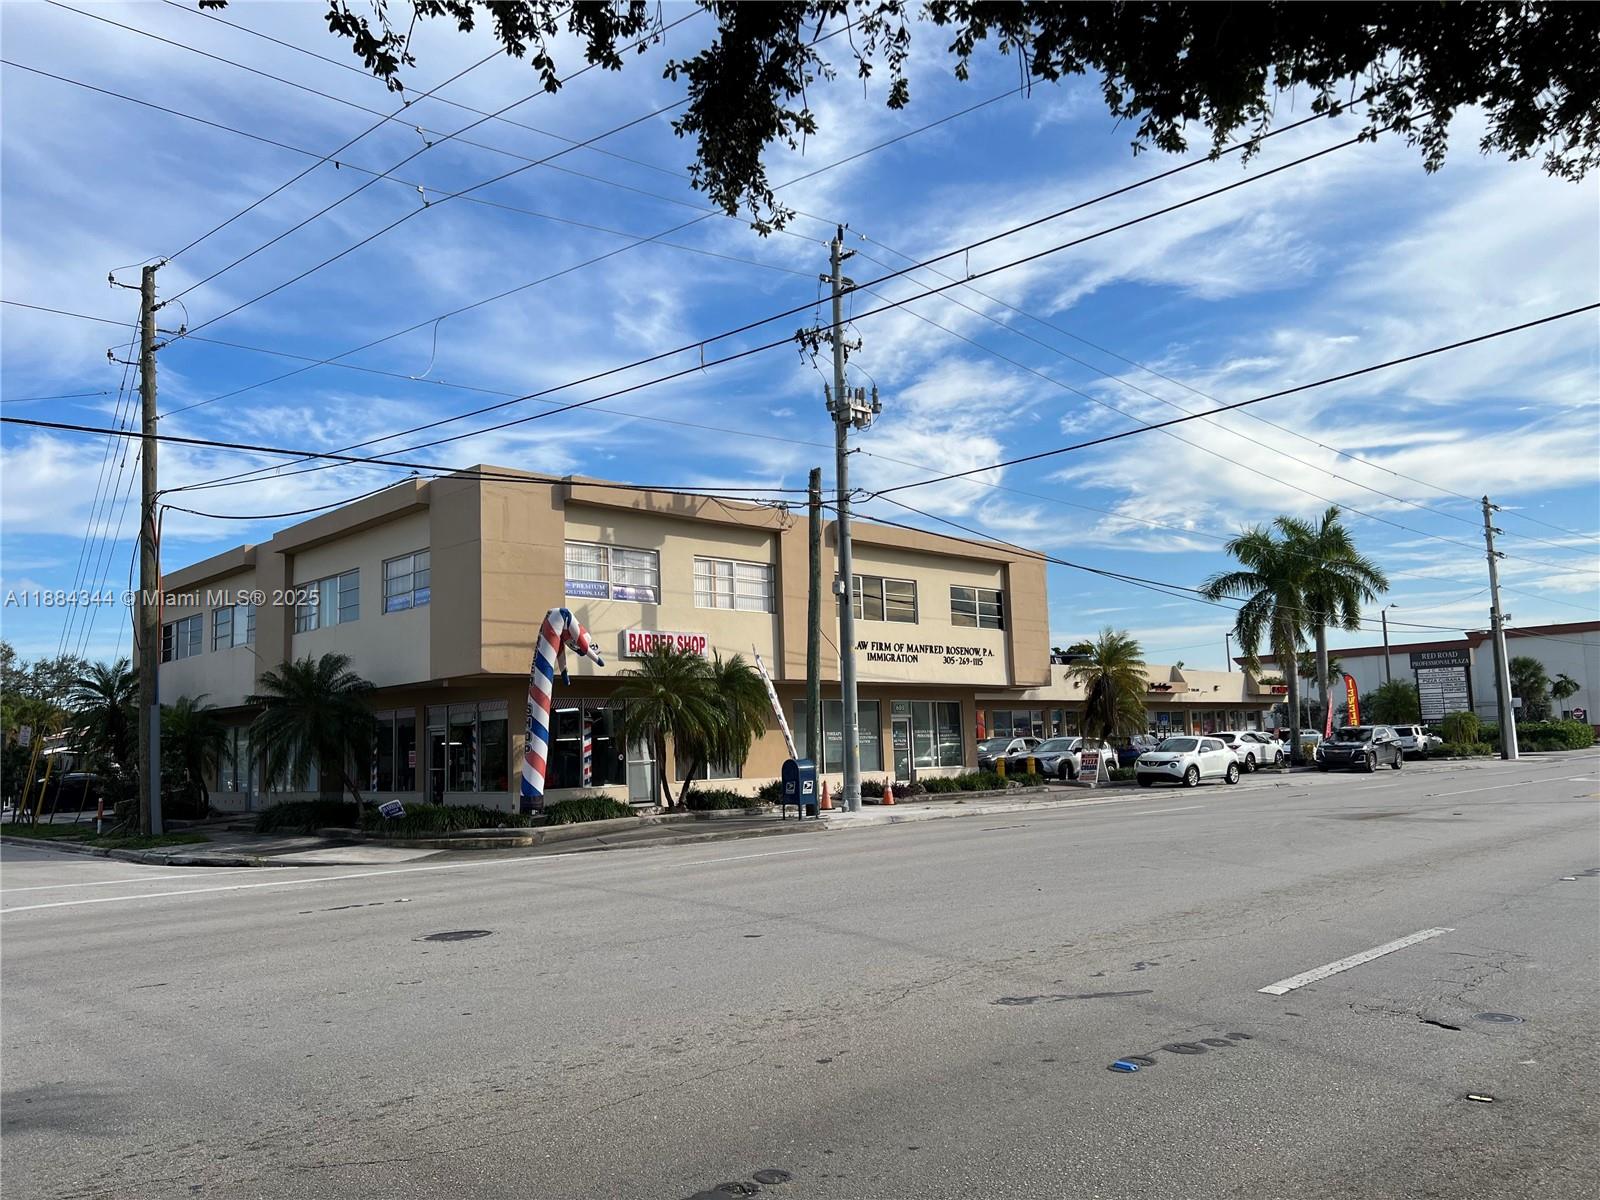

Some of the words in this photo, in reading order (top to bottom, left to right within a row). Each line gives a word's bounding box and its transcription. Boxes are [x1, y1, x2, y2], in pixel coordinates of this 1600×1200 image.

[677, 635, 706, 656] SHOP
[854, 641, 868, 650] AW
[871, 642, 891, 651] FIRM
[894, 643, 905, 652] OF
[907, 644, 944, 654] MANFRED
[946, 646, 981, 657] ROSENOW,
[867, 654, 918, 663] IMMIGRATION
[943, 656, 983, 666] 305-269-1115
[1438, 651, 1458, 659] ROAD
